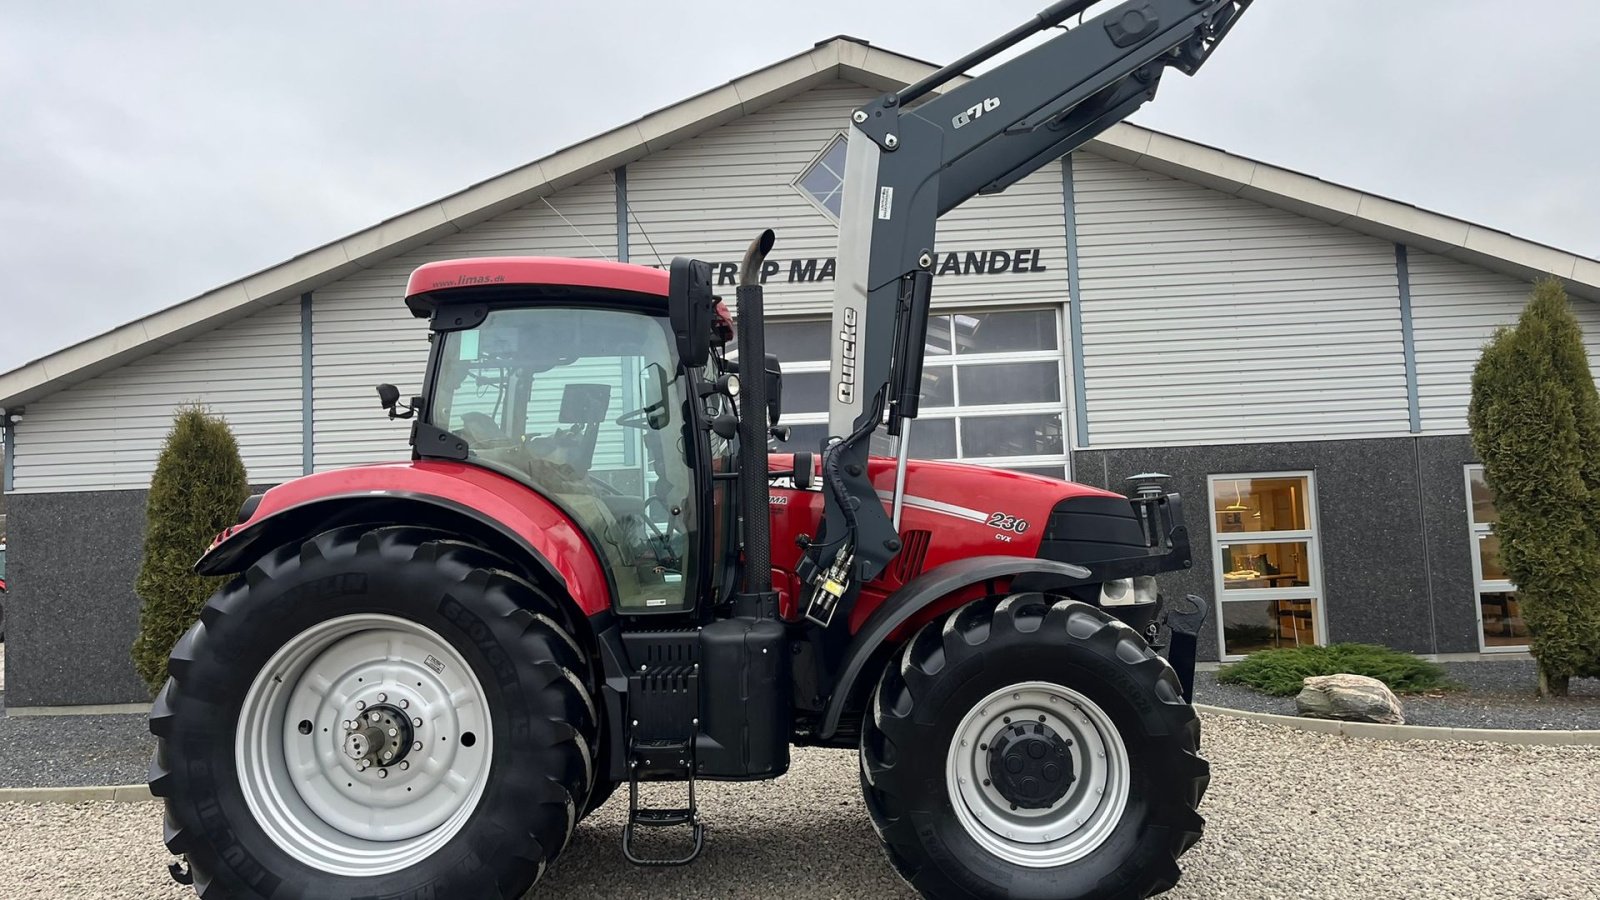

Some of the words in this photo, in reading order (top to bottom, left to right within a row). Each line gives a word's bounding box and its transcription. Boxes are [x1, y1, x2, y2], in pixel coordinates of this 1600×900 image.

[432, 274, 505, 288] www.limas.dk
[987, 511, 1030, 534] 230
[995, 533, 1011, 543] CVX
